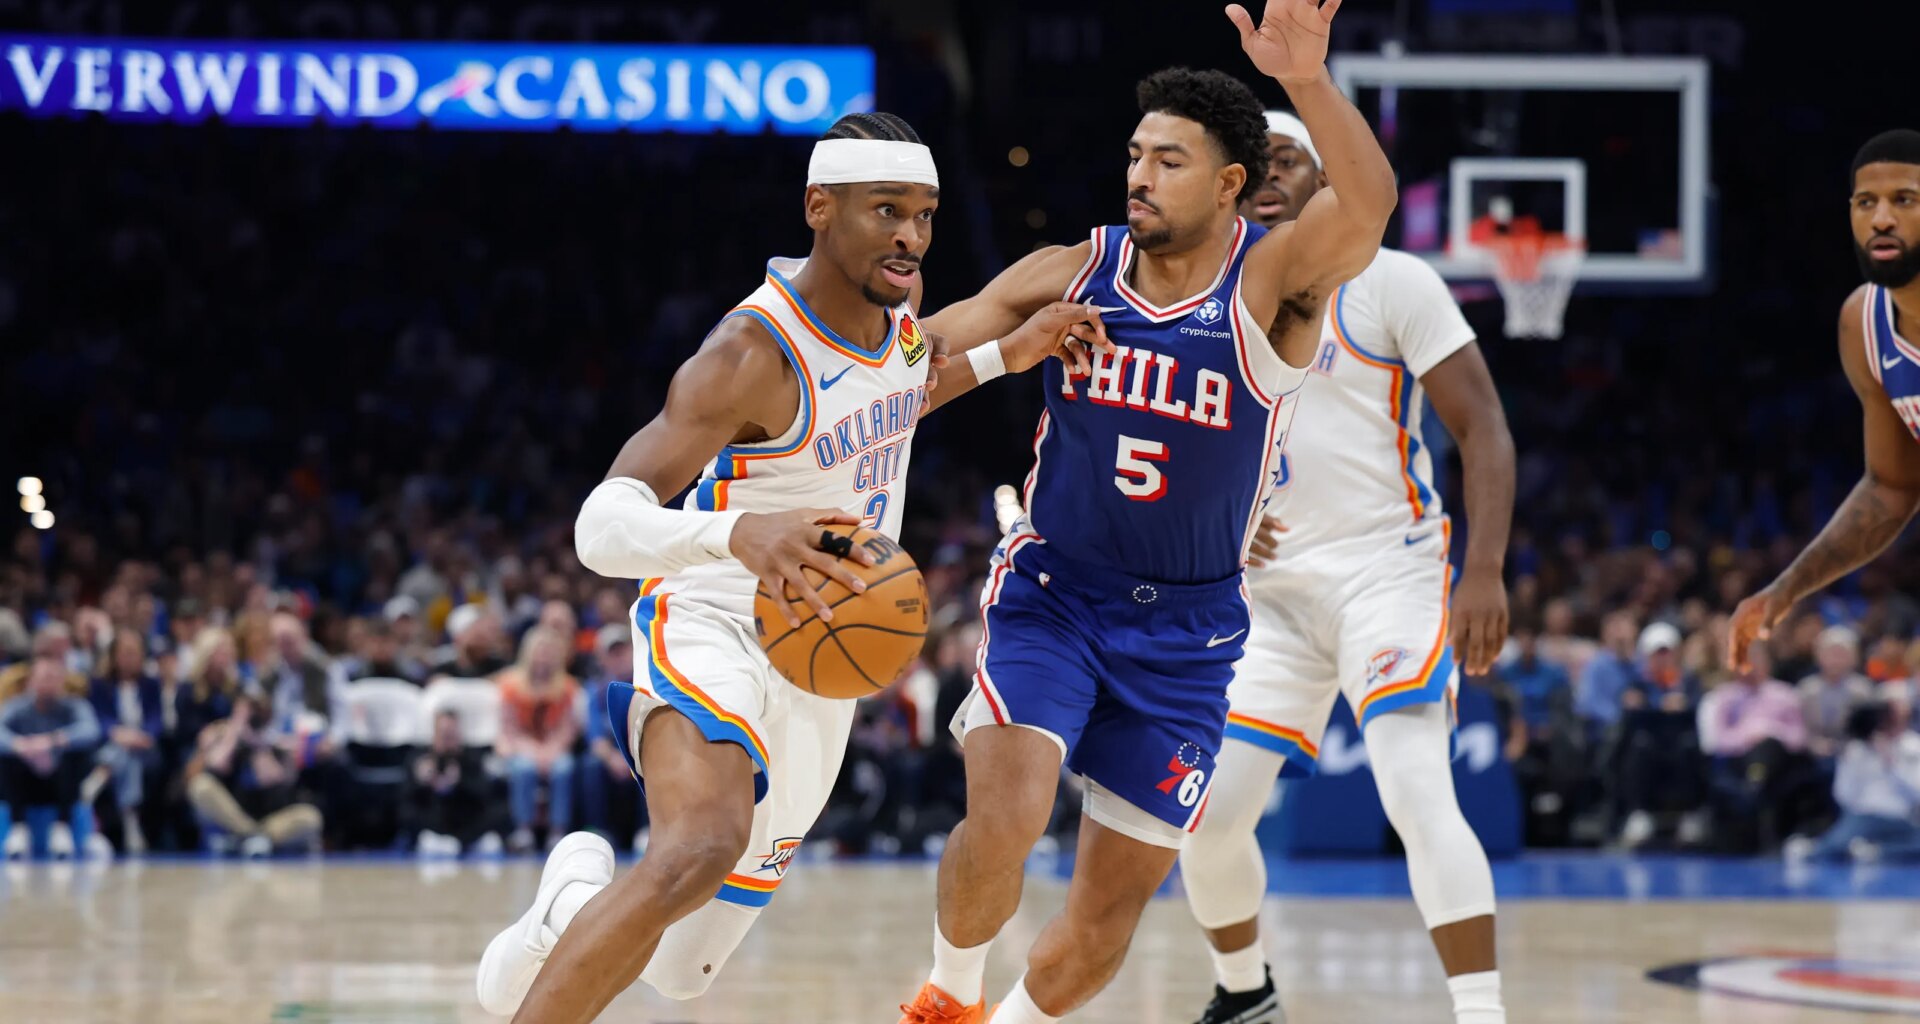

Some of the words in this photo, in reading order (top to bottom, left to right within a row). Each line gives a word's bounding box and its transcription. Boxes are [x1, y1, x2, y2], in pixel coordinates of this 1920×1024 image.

[495, 55, 832, 123] CASINO
[1180, 327, 1231, 339] crypto.com
[1061, 344, 1233, 431] PHILA
[853, 437, 907, 494] CITY
[1114, 434, 1170, 502] 5
[1155, 754, 1205, 807] 76
